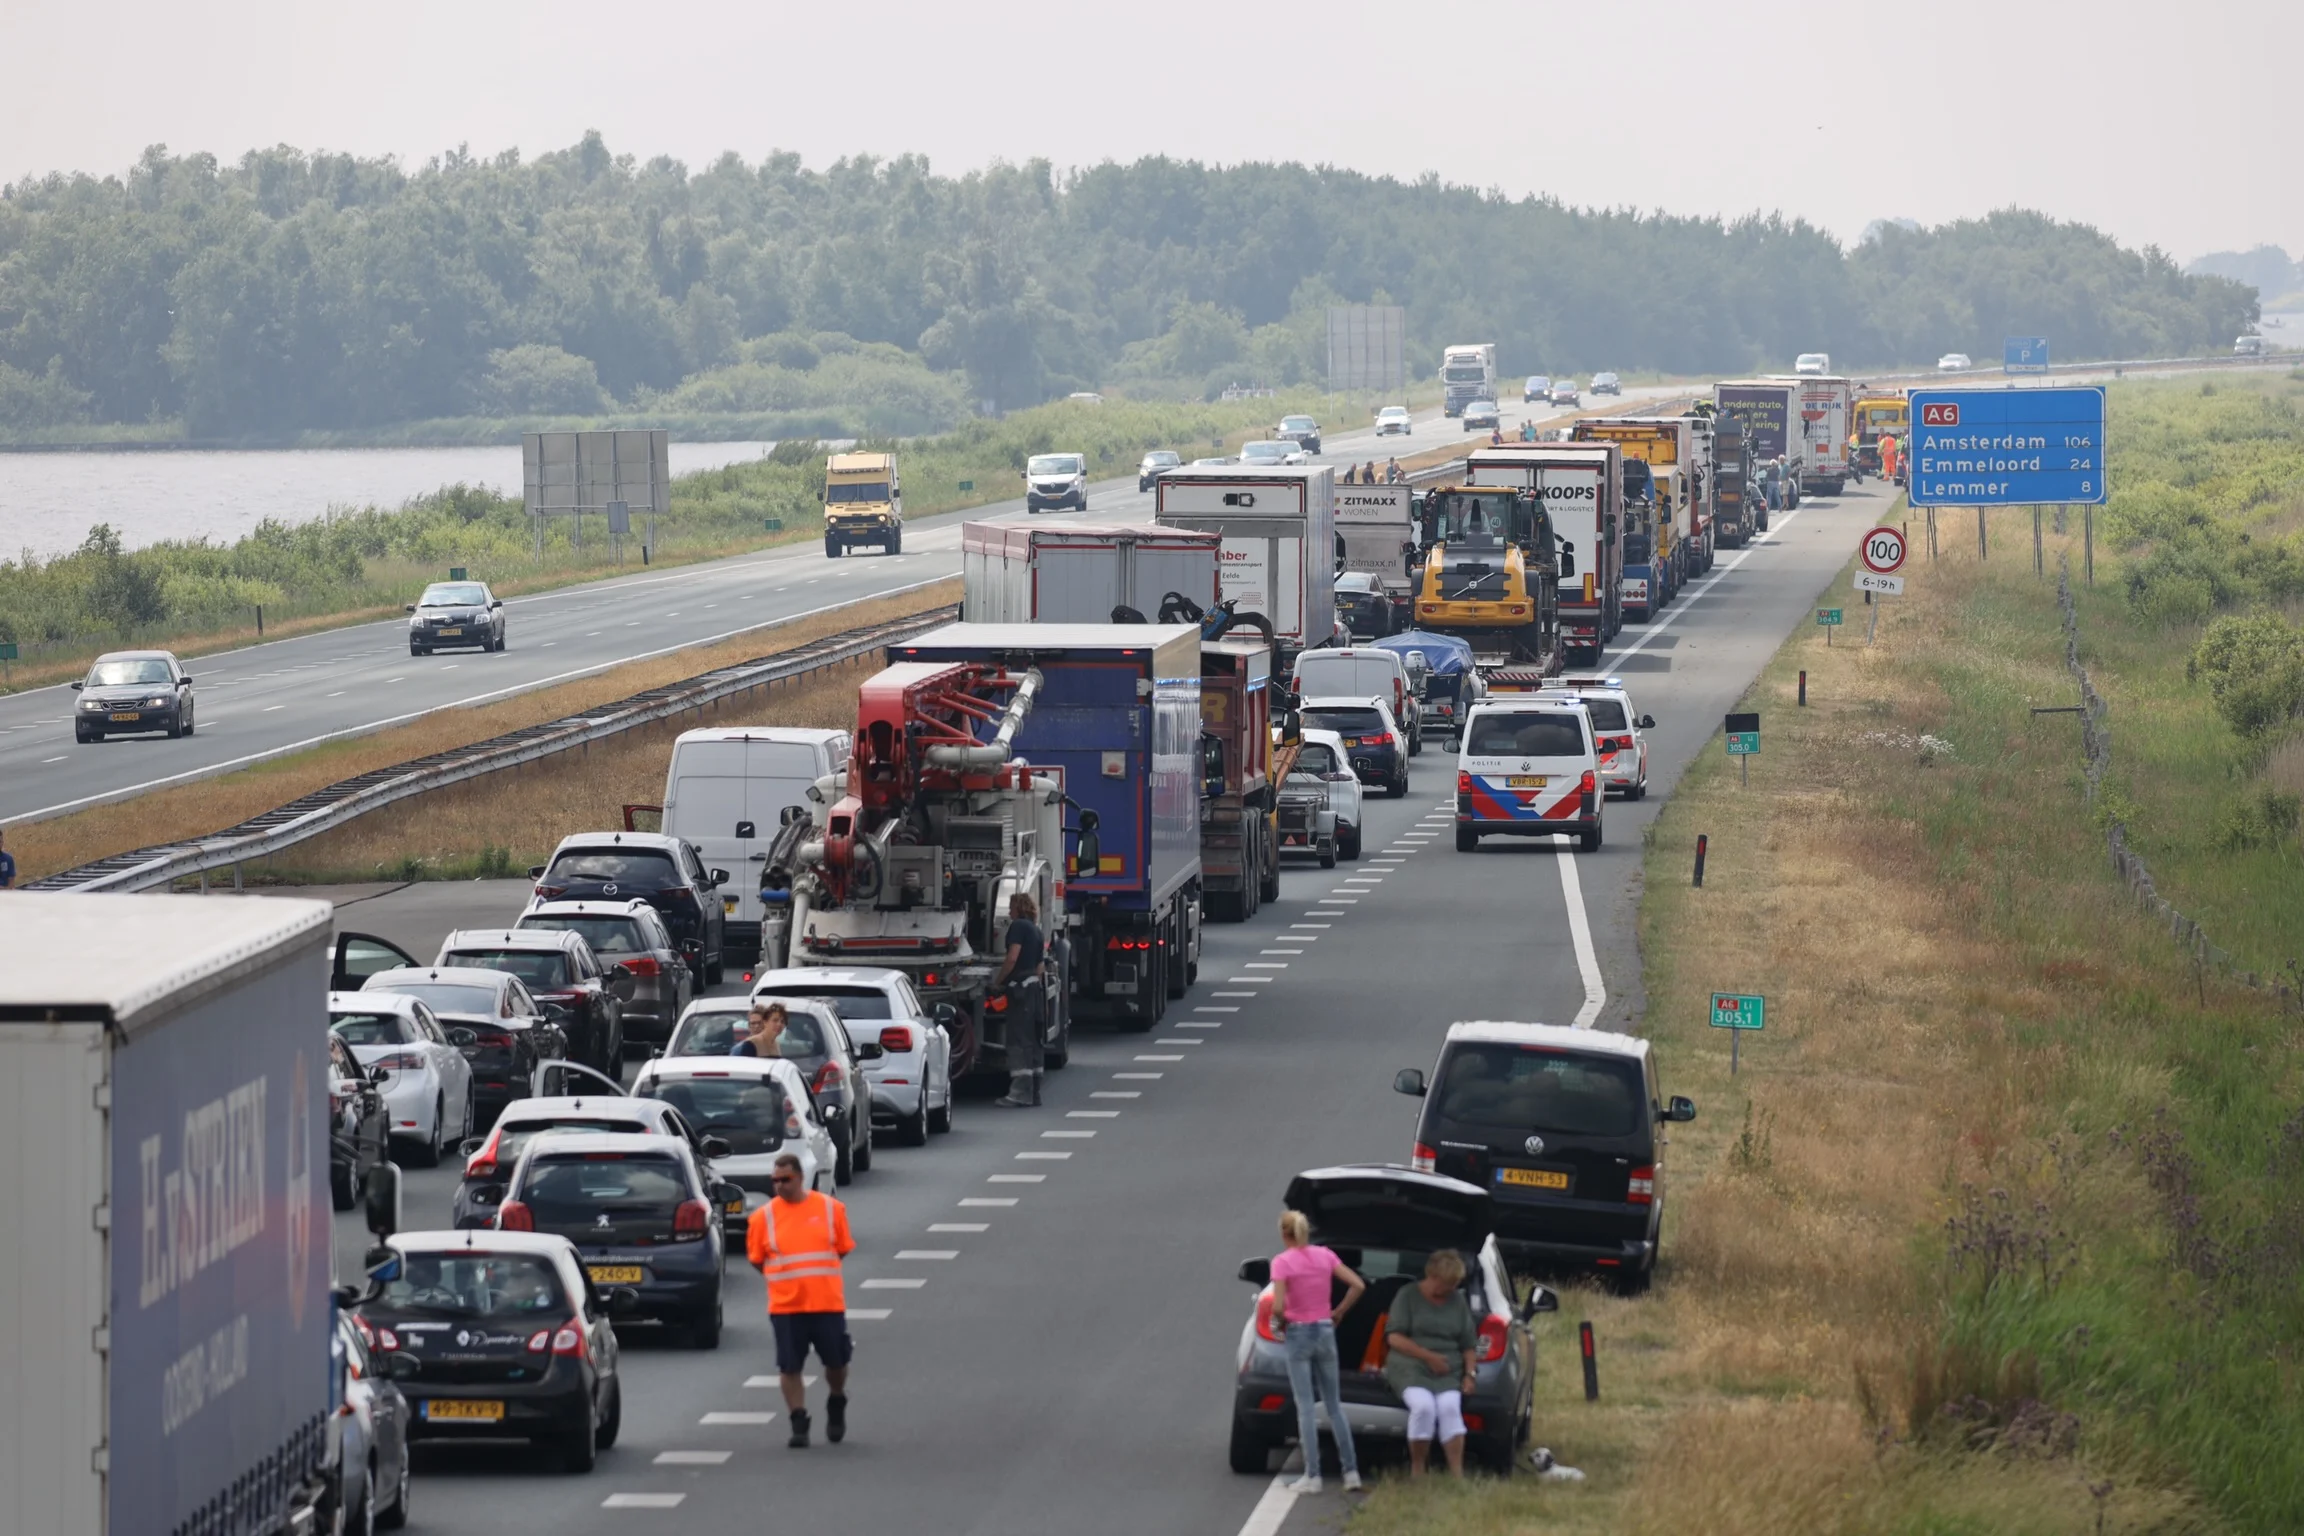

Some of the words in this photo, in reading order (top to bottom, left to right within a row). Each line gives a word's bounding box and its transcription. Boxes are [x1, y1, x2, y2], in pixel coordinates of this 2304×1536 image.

[1759, 401, 1784, 410] auto,
[1927, 407, 1955, 422] A6
[1923, 434, 2046, 450] Amsterdam
[2064, 436, 2091, 448] 106
[1921, 456, 2040, 473] Emmeloord
[2069, 458, 2091, 471] 24
[1541, 486, 1595, 500] KOOPS
[1922, 480, 2009, 496] Lemmer
[2081, 480, 2092, 493] 8
[1344, 497, 1397, 506] ZITMAXX
[1344, 508, 1379, 516] WONEN
[1491, 518, 1500, 527] 40
[1220, 550, 1248, 561] aber
[1870, 539, 1901, 561] 100
[1346, 558, 1397, 568] .zitmaxx.nl
[1729, 743, 1750, 752] 305.0
[1721, 1000, 1735, 1009] A6
[1743, 1001, 1752, 1010] Li
[1715, 1010, 1752, 1025] 305.1
